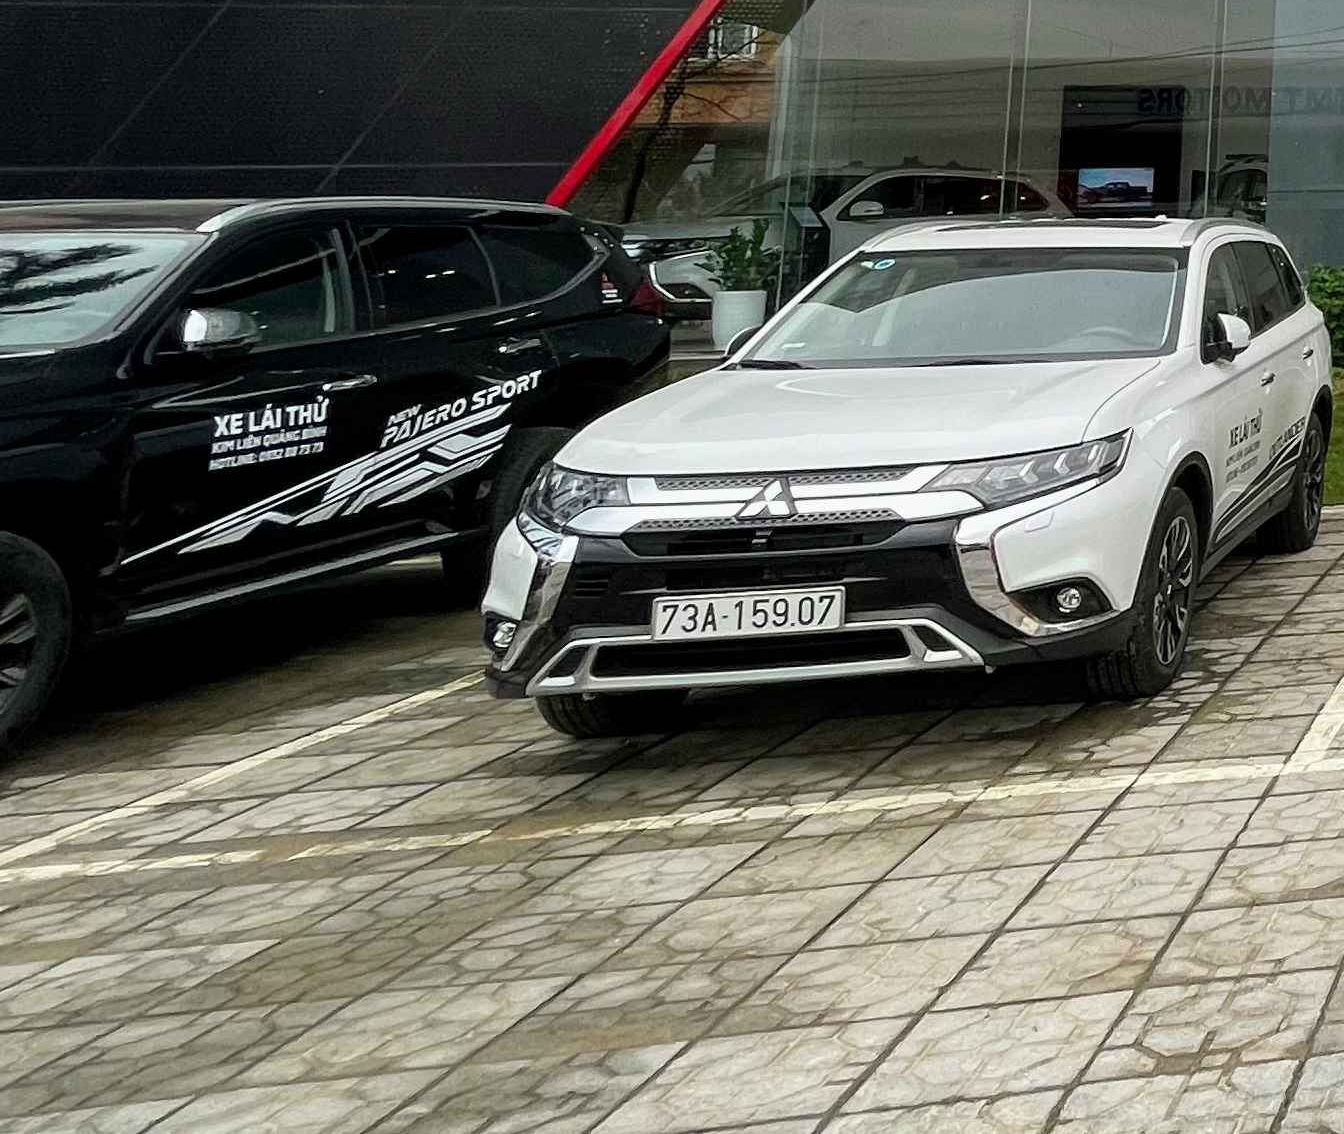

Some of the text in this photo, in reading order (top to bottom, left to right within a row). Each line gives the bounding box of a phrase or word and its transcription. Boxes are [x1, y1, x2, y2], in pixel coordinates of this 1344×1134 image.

[213, 395, 330, 438] XE LÁI THỬ
[379, 369, 543, 449] PAJERO SPORT
[387, 404, 423, 428] NEW
[661, 594, 836, 635] 73A-159.07
